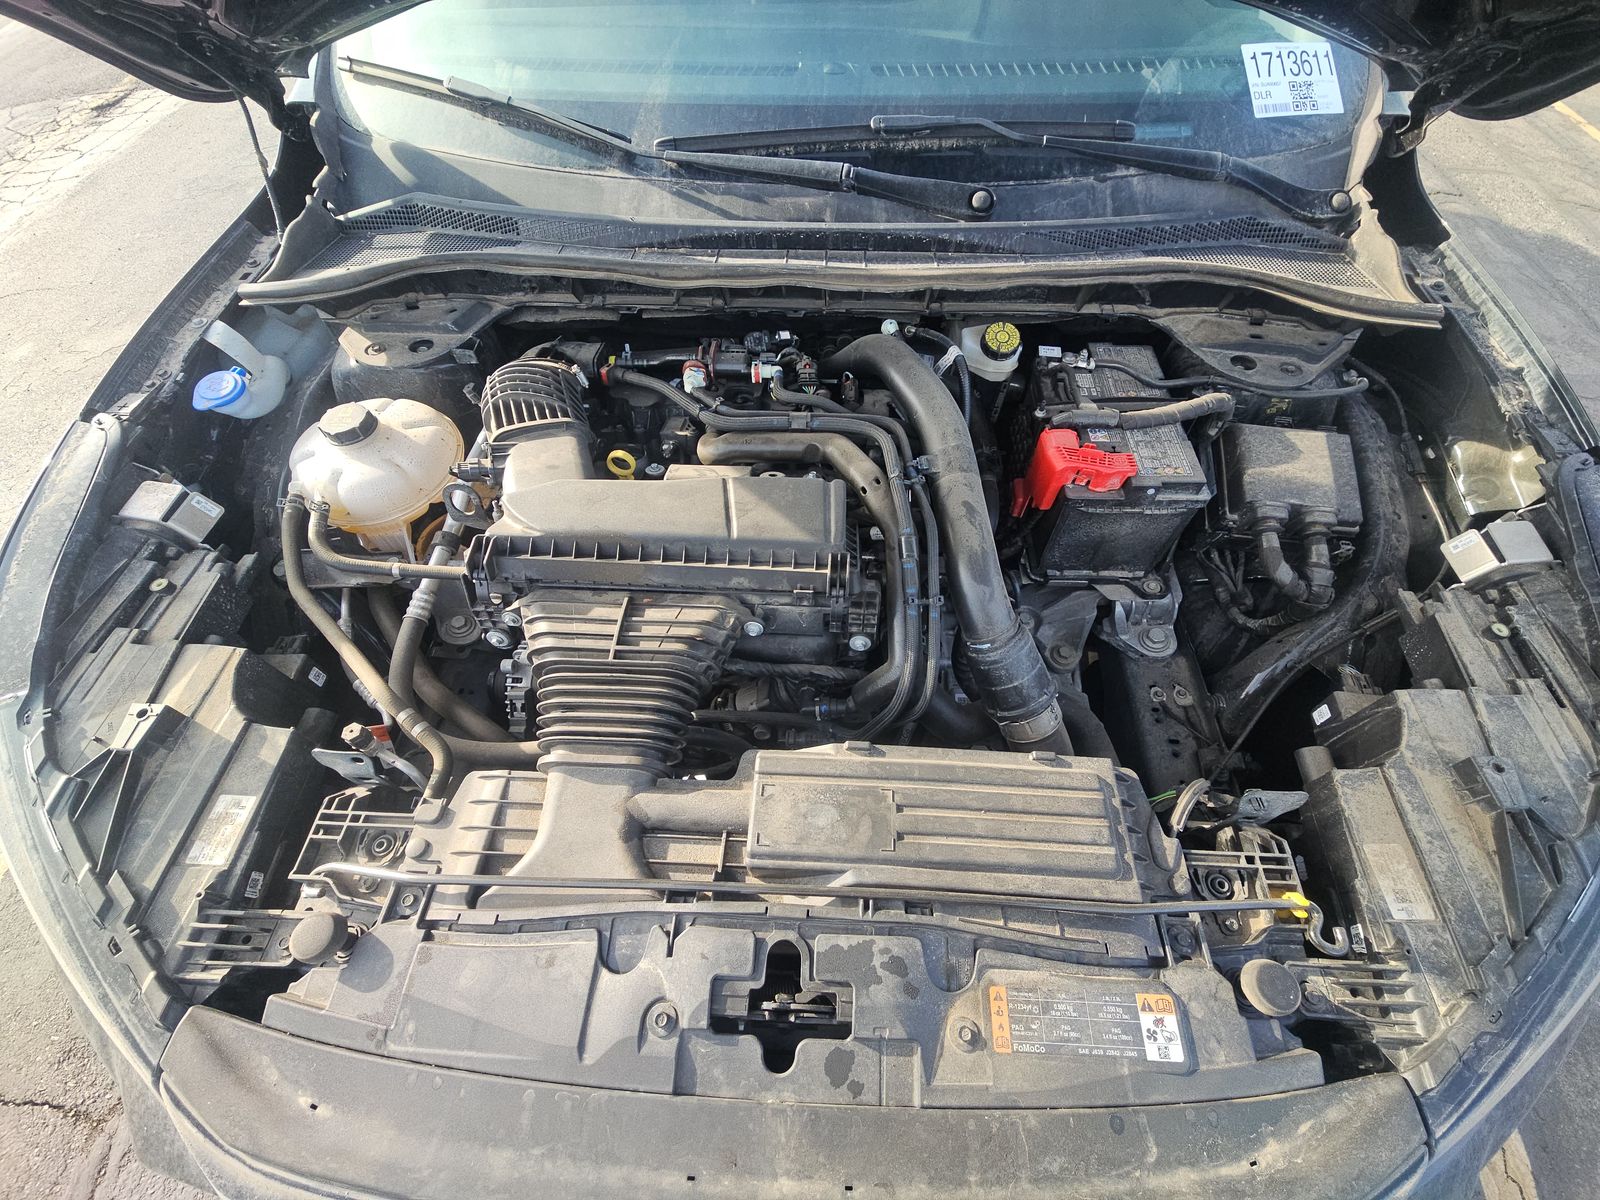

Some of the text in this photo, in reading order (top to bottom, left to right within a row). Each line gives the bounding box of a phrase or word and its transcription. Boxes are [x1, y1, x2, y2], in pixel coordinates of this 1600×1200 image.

[1250, 49, 1334, 78] 1713611
[1253, 90, 1273, 100] DLR
[1013, 1043, 1046, 1053] FoMoCo
